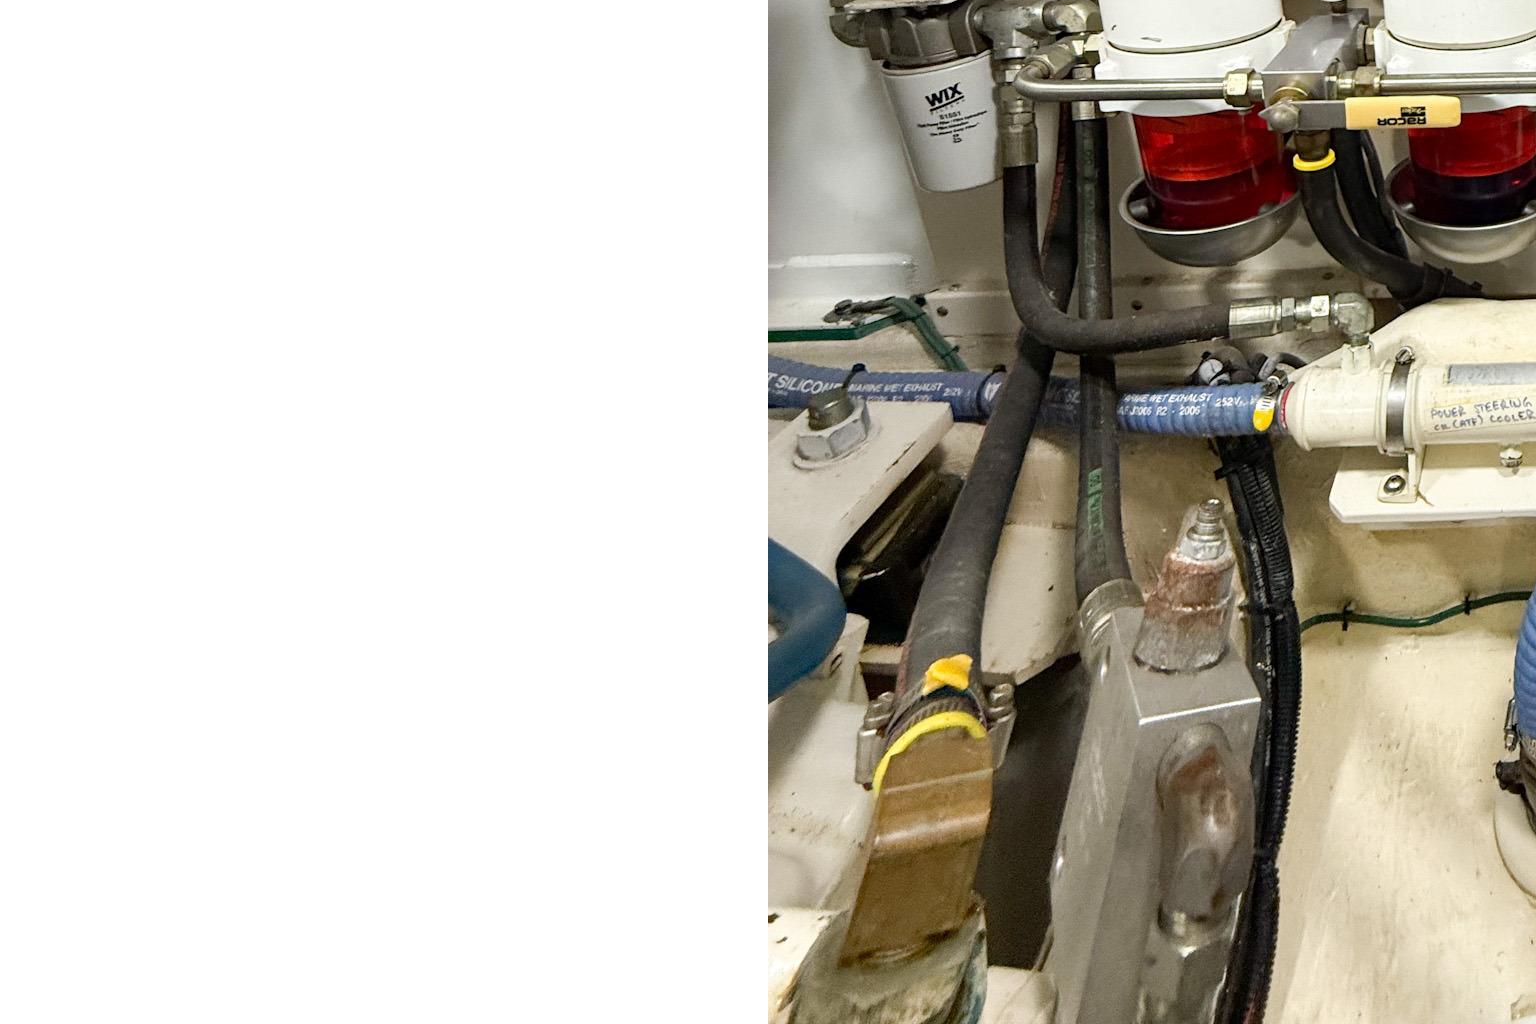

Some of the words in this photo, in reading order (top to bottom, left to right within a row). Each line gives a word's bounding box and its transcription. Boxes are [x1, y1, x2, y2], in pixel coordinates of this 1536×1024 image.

[925, 82, 963, 107] WIX
[776, 375, 843, 395] SILICON
[903, 382, 945, 392] EXHAUST
[1168, 393, 1214, 403] EXHAUST
[1474, 396, 1533, 415] STEERING
